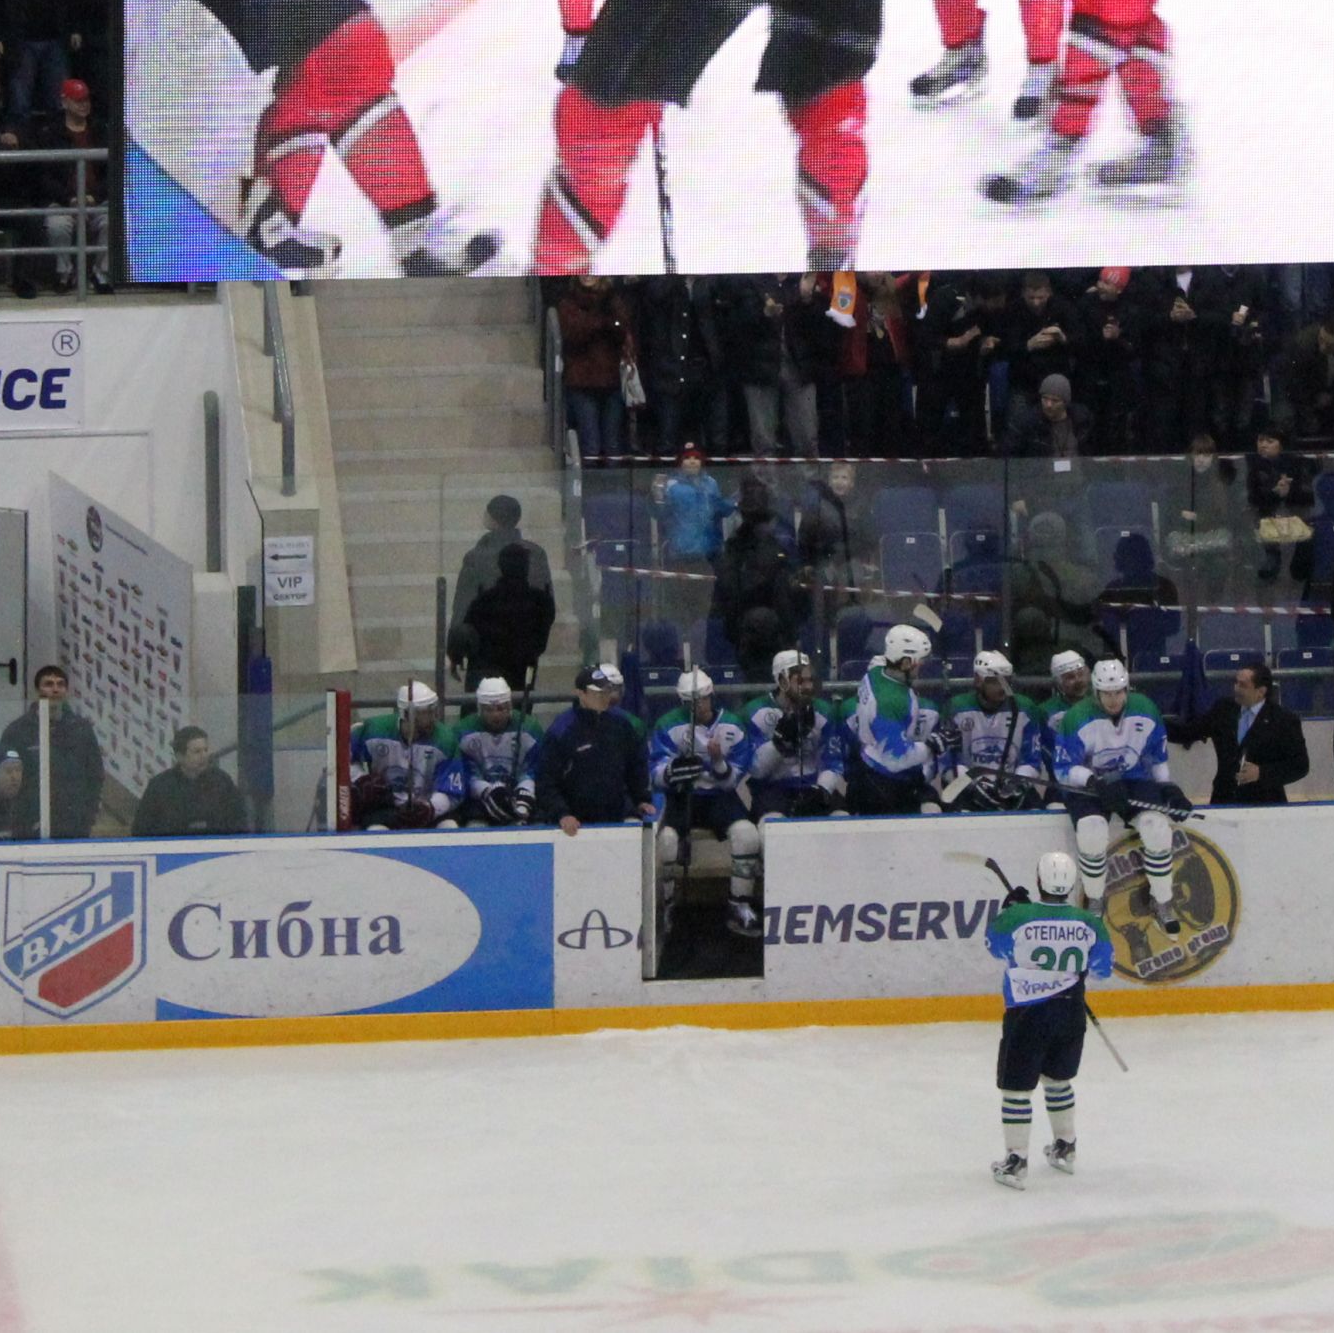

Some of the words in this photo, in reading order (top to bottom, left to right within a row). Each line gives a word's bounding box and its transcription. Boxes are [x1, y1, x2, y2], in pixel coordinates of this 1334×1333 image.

[278, 576, 303, 589] VIP
[447, 771, 463, 791] 14
[22, 894, 113, 974] ВХЛ
[166, 899, 405, 963] Сибна
